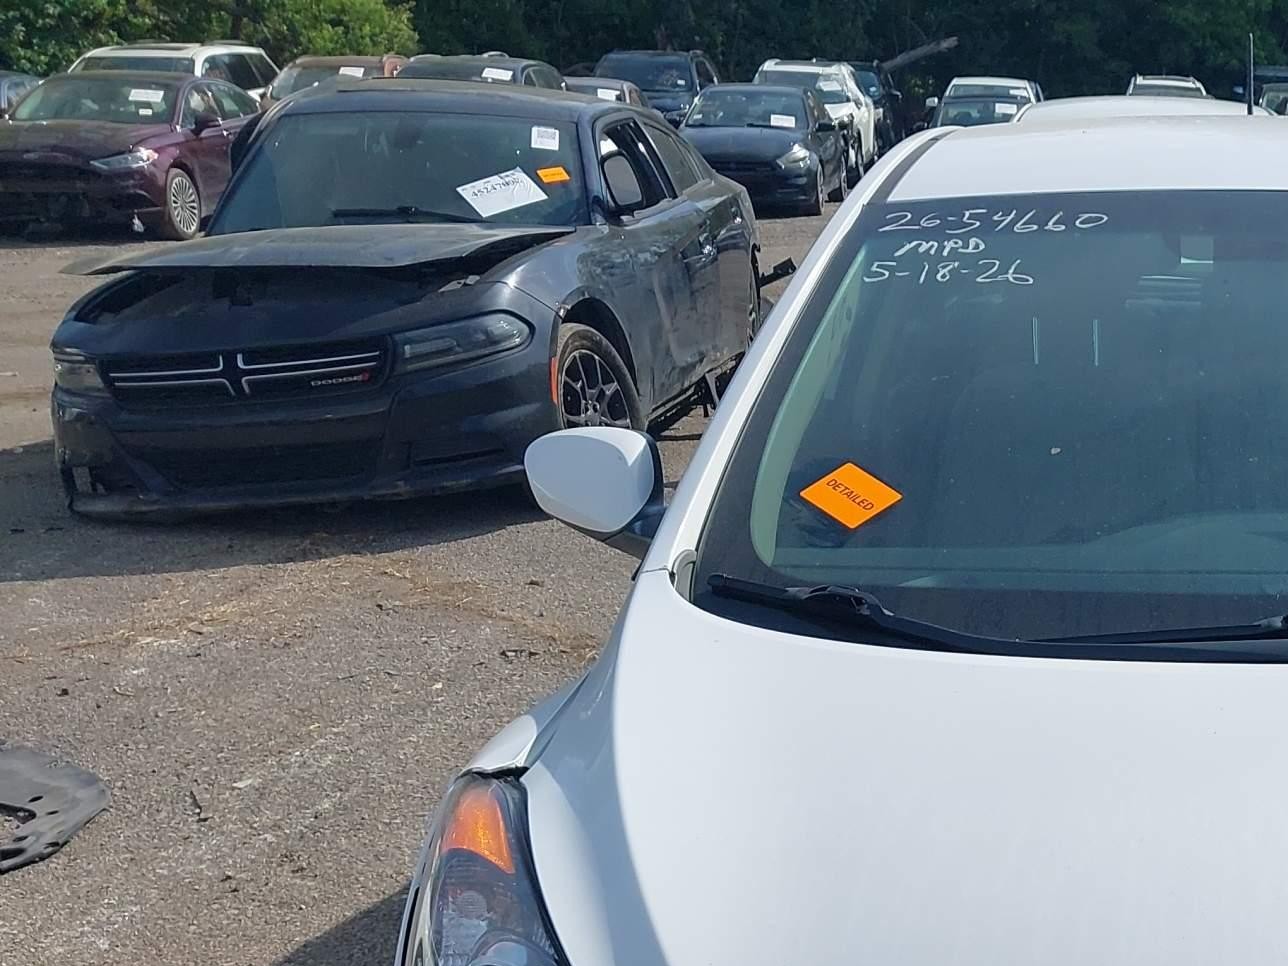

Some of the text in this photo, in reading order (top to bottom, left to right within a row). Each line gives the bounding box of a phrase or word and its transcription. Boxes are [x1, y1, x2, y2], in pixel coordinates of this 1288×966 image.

[878, 208, 1109, 234] 26-54660
[863, 258, 1034, 285] 5-18-26
[826, 478, 875, 511] DETAILED
